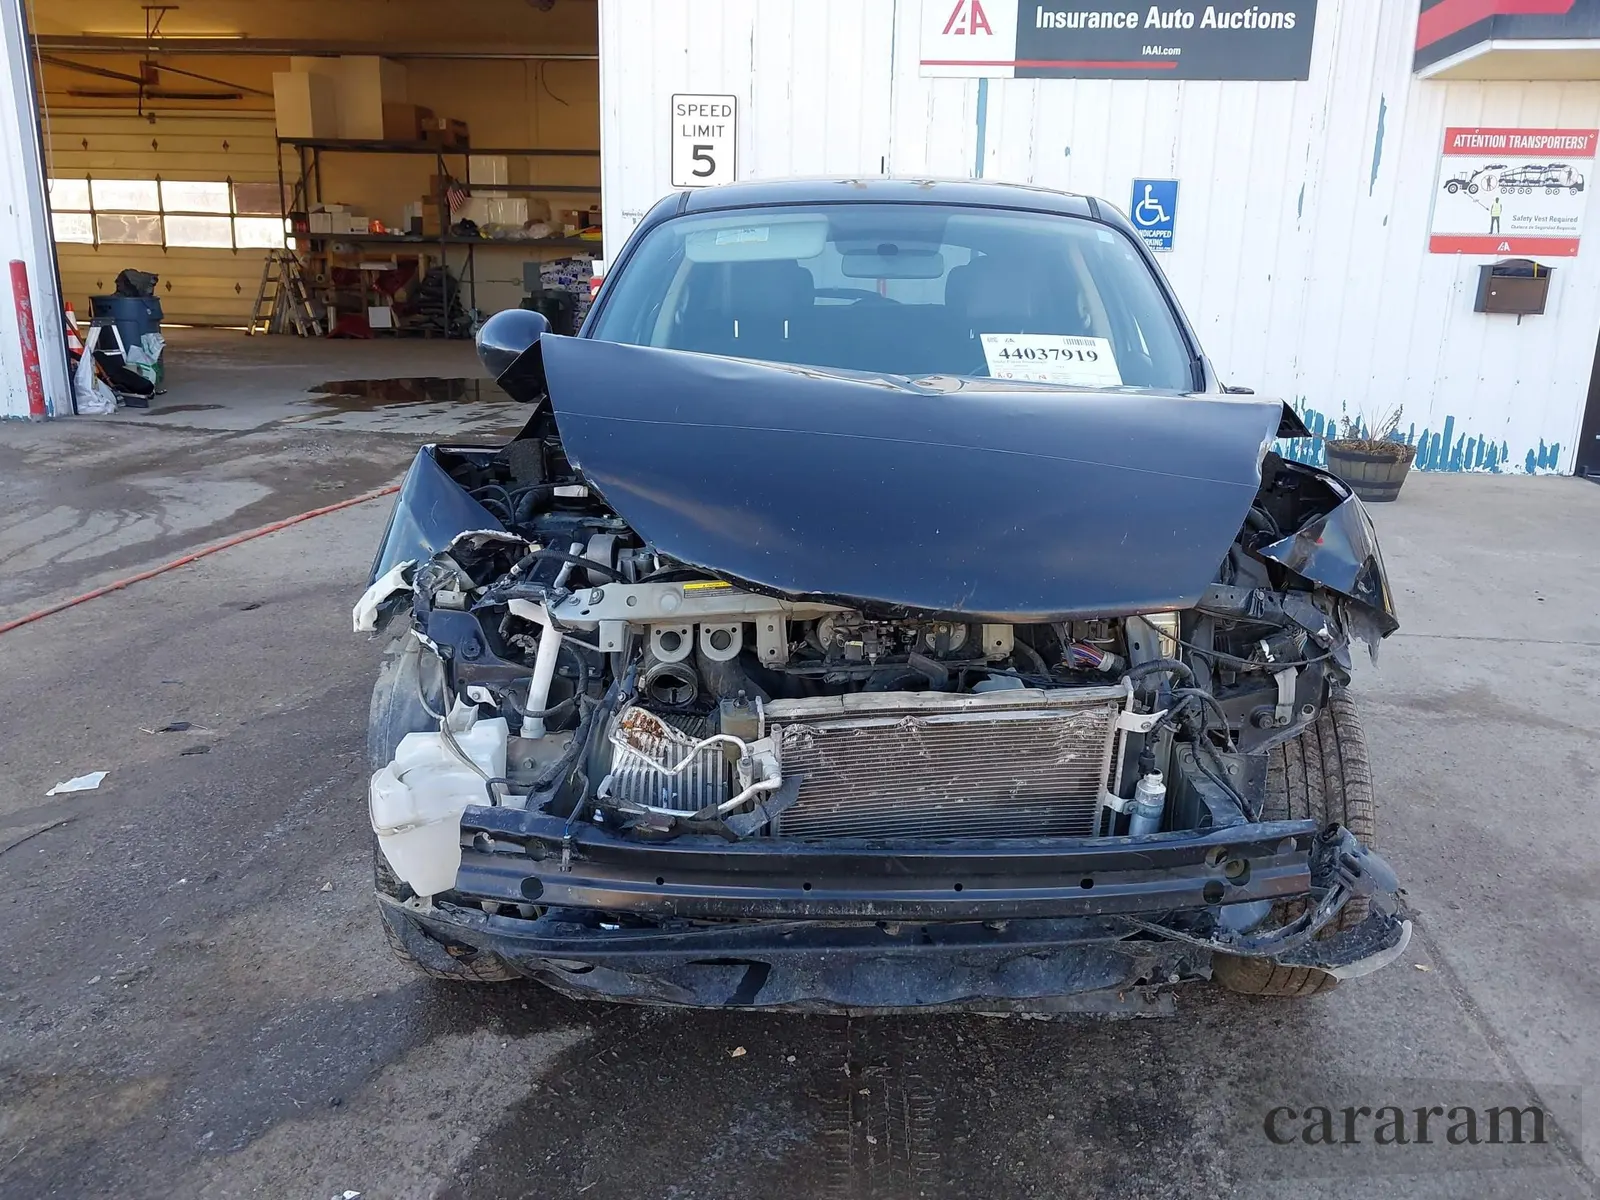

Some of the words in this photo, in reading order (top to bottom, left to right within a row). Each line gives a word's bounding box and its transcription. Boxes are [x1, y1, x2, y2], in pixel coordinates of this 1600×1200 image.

[1035, 6, 1139, 30] Insurance
[1144, 7, 1195, 29] Auto
[1200, 6, 1297, 30] Auctions
[1142, 45, 1181, 56] IAAI.com
[677, 104, 732, 117] SPEED
[682, 124, 725, 137] LIMIT
[1453, 134, 1506, 148] ATTENTION
[1508, 135, 1588, 150] TRANSPORTERS!
[692, 144, 716, 177] 5
[1512, 215, 1533, 223] Safety
[1549, 215, 1579, 223] Required
[998, 347, 1099, 363] 44037919
